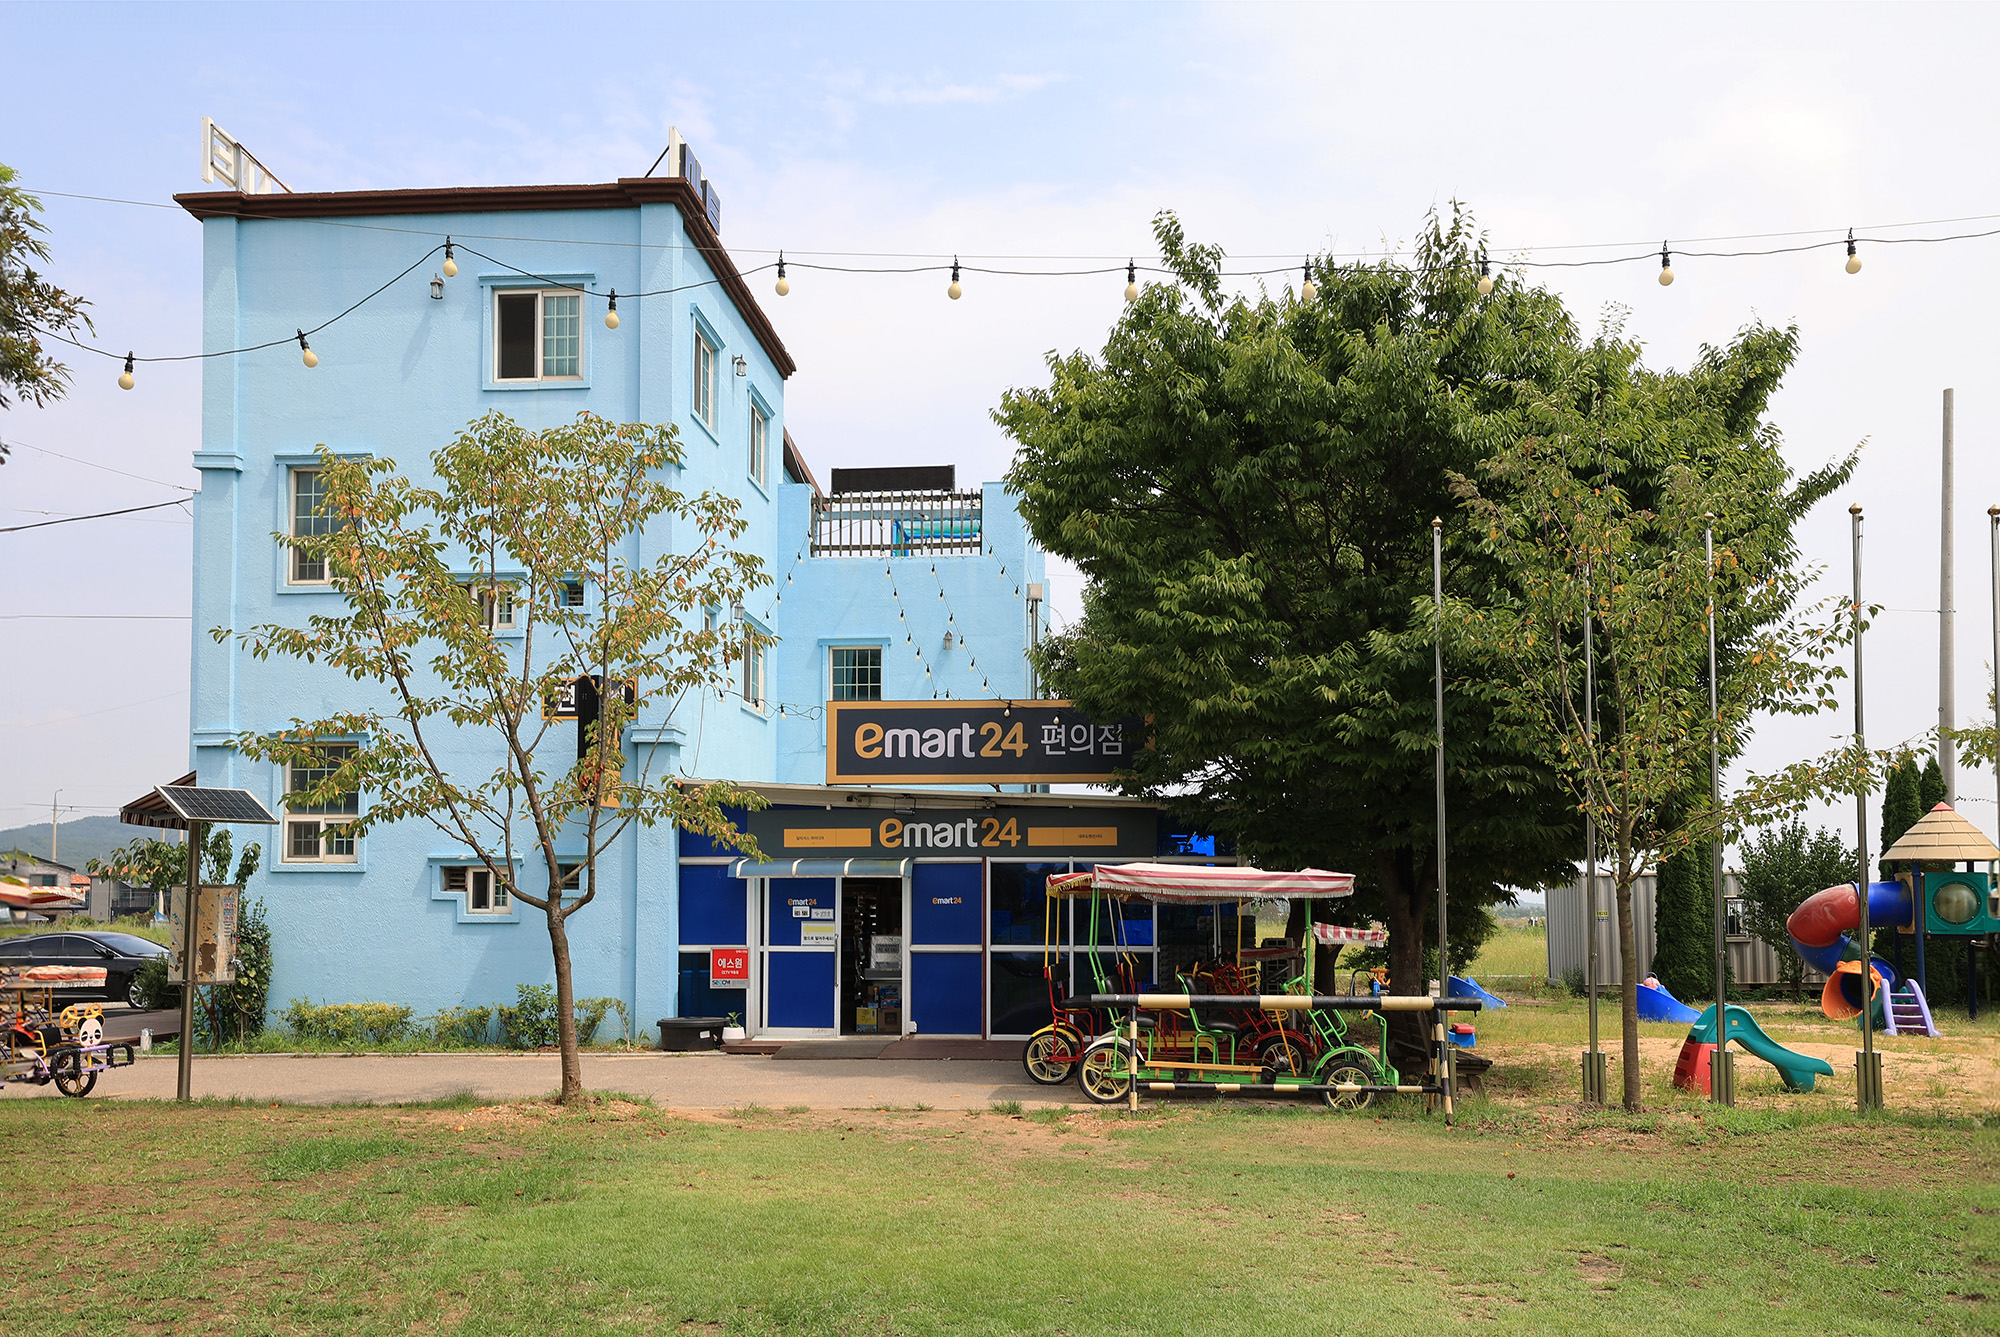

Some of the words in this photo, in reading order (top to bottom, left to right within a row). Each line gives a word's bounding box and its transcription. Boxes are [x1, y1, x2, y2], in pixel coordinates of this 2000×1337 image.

[854, 721, 1029, 759] emart24
[1040, 723, 1124, 756] 편의점
[879, 817, 1022, 848] emart24
[787, 898, 818, 906] emart24
[932, 896, 963, 905] emart24
[717, 957, 743, 969] 에스원
